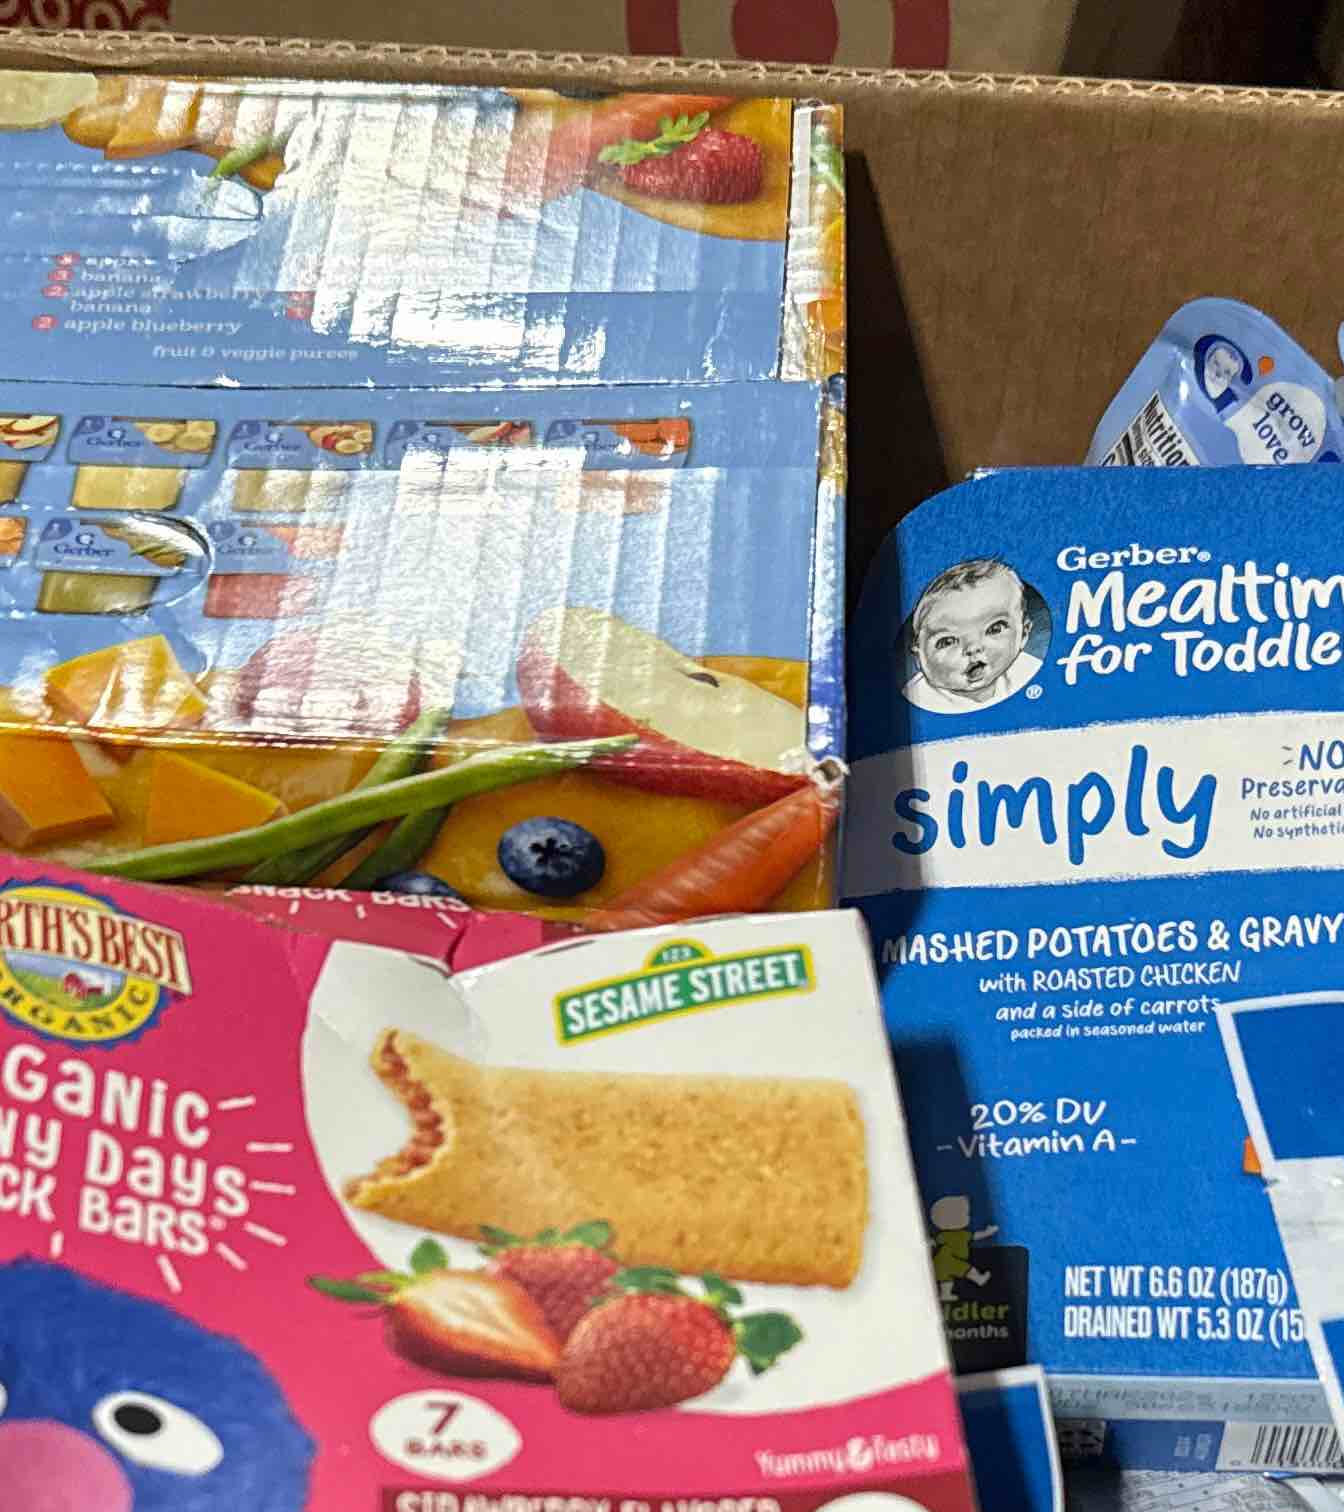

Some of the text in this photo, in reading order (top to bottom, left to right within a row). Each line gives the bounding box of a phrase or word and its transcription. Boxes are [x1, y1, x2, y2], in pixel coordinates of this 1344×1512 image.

[131, 318, 243, 335] blueberry
[1266, 391, 1315, 448] grow
[1252, 411, 1288, 465] love
[1057, 636, 1152, 686] for
[893, 746, 1218, 865] simply
[1250, 808, 1270, 823] No
[1274, 803, 1342, 823] artificial
[1253, 824, 1272, 839] No
[99, 915, 191, 994] BEST
[882, 912, 1344, 966] MASHED POTATOES & GRAVY
[565, 951, 804, 1036] SESAME STREET
[979, 960, 1240, 993] with ROASTED CHICKEN
[996, 995, 1221, 1021] and a side of carrots
[1010, 1019, 1205, 1042] packed in seasoned water
[971, 1097, 1107, 1131] 20% DV
[1091, 1131, 1117, 1152] A
[1065, 1265, 1288, 1306] NET WT 6.6 OZ (187g)
[1064, 1306, 1264, 1342] DRAINED WT 5.3 OZ
[425, 1402, 462, 1435] 7
[405, 1438, 488, 1461] BARS
